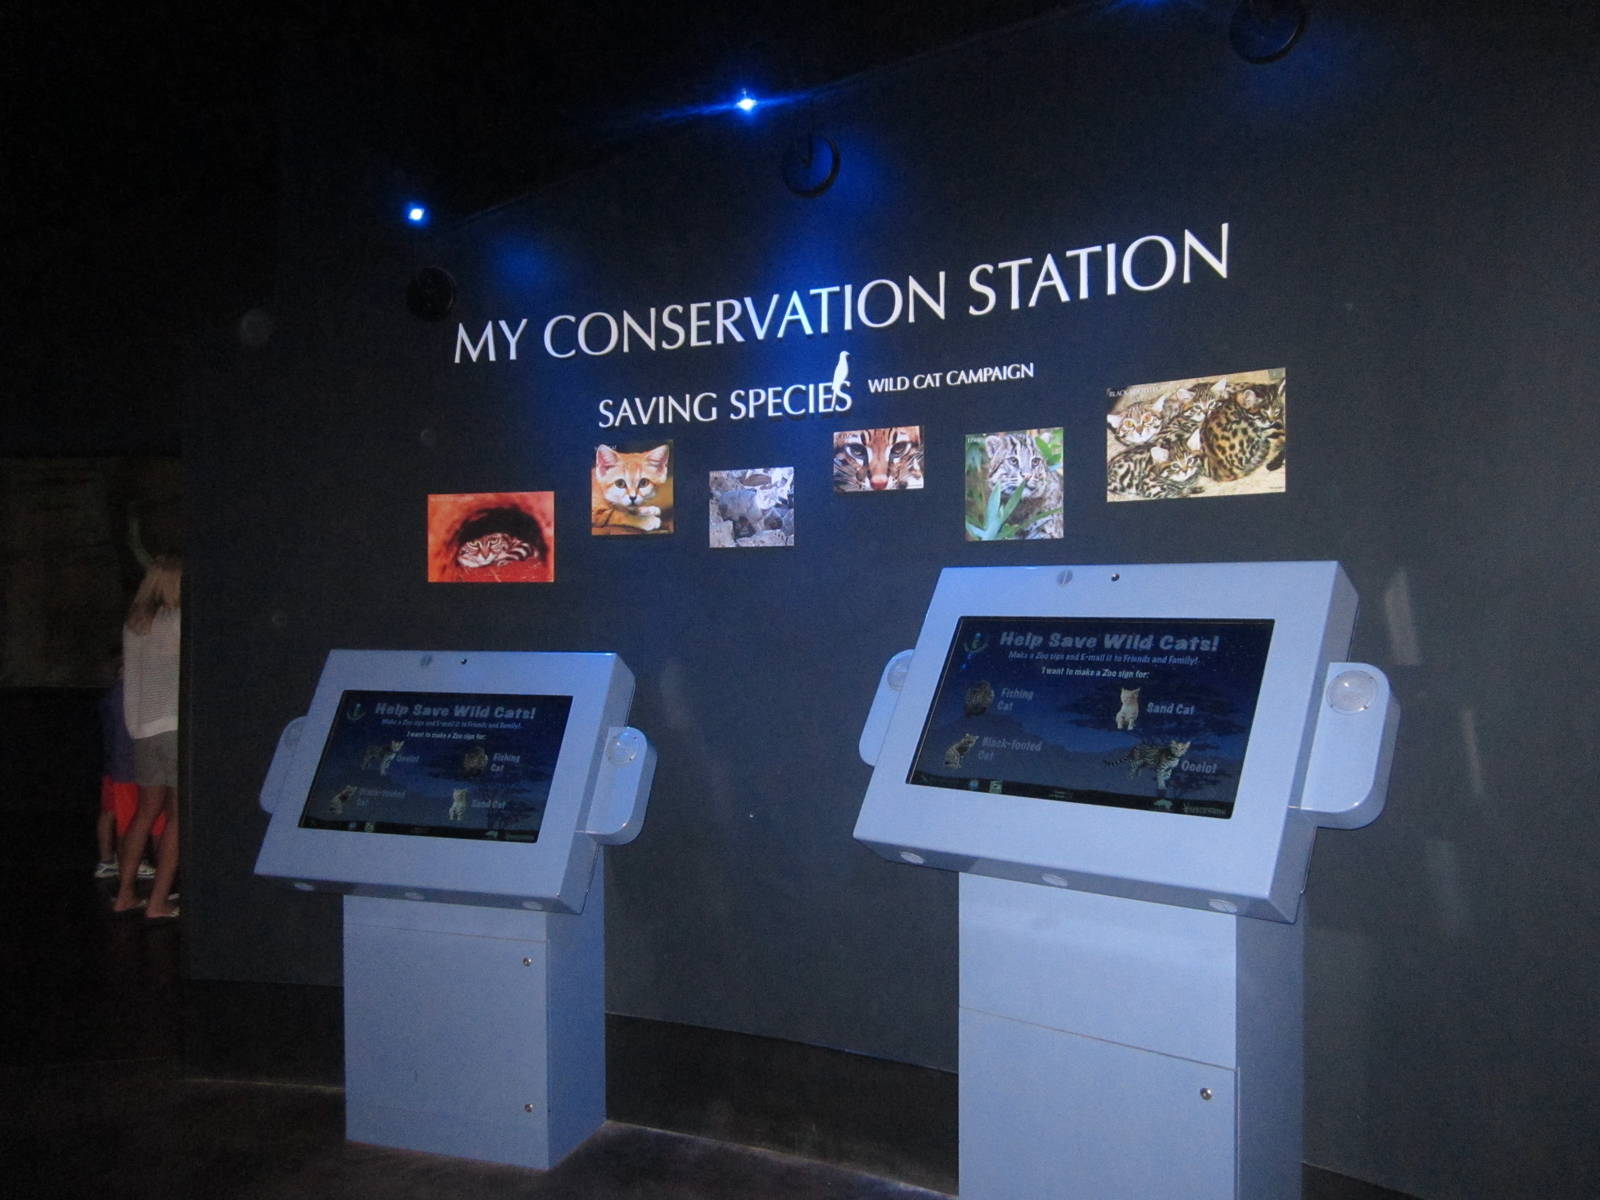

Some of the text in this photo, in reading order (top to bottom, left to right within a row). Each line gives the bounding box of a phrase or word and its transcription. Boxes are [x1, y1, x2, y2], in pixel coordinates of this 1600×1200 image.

[454, 223, 1230, 364] MY CONSERVATION STATION
[868, 362, 1035, 393] WILD CAT CAMPAIGN
[598, 380, 853, 428] SAVING SPECIES
[999, 631, 1220, 652] Help Save Wild Cats!
[375, 702, 537, 720] Help Save Wild Cats!
[1146, 702, 1196, 716] Sand Cat
